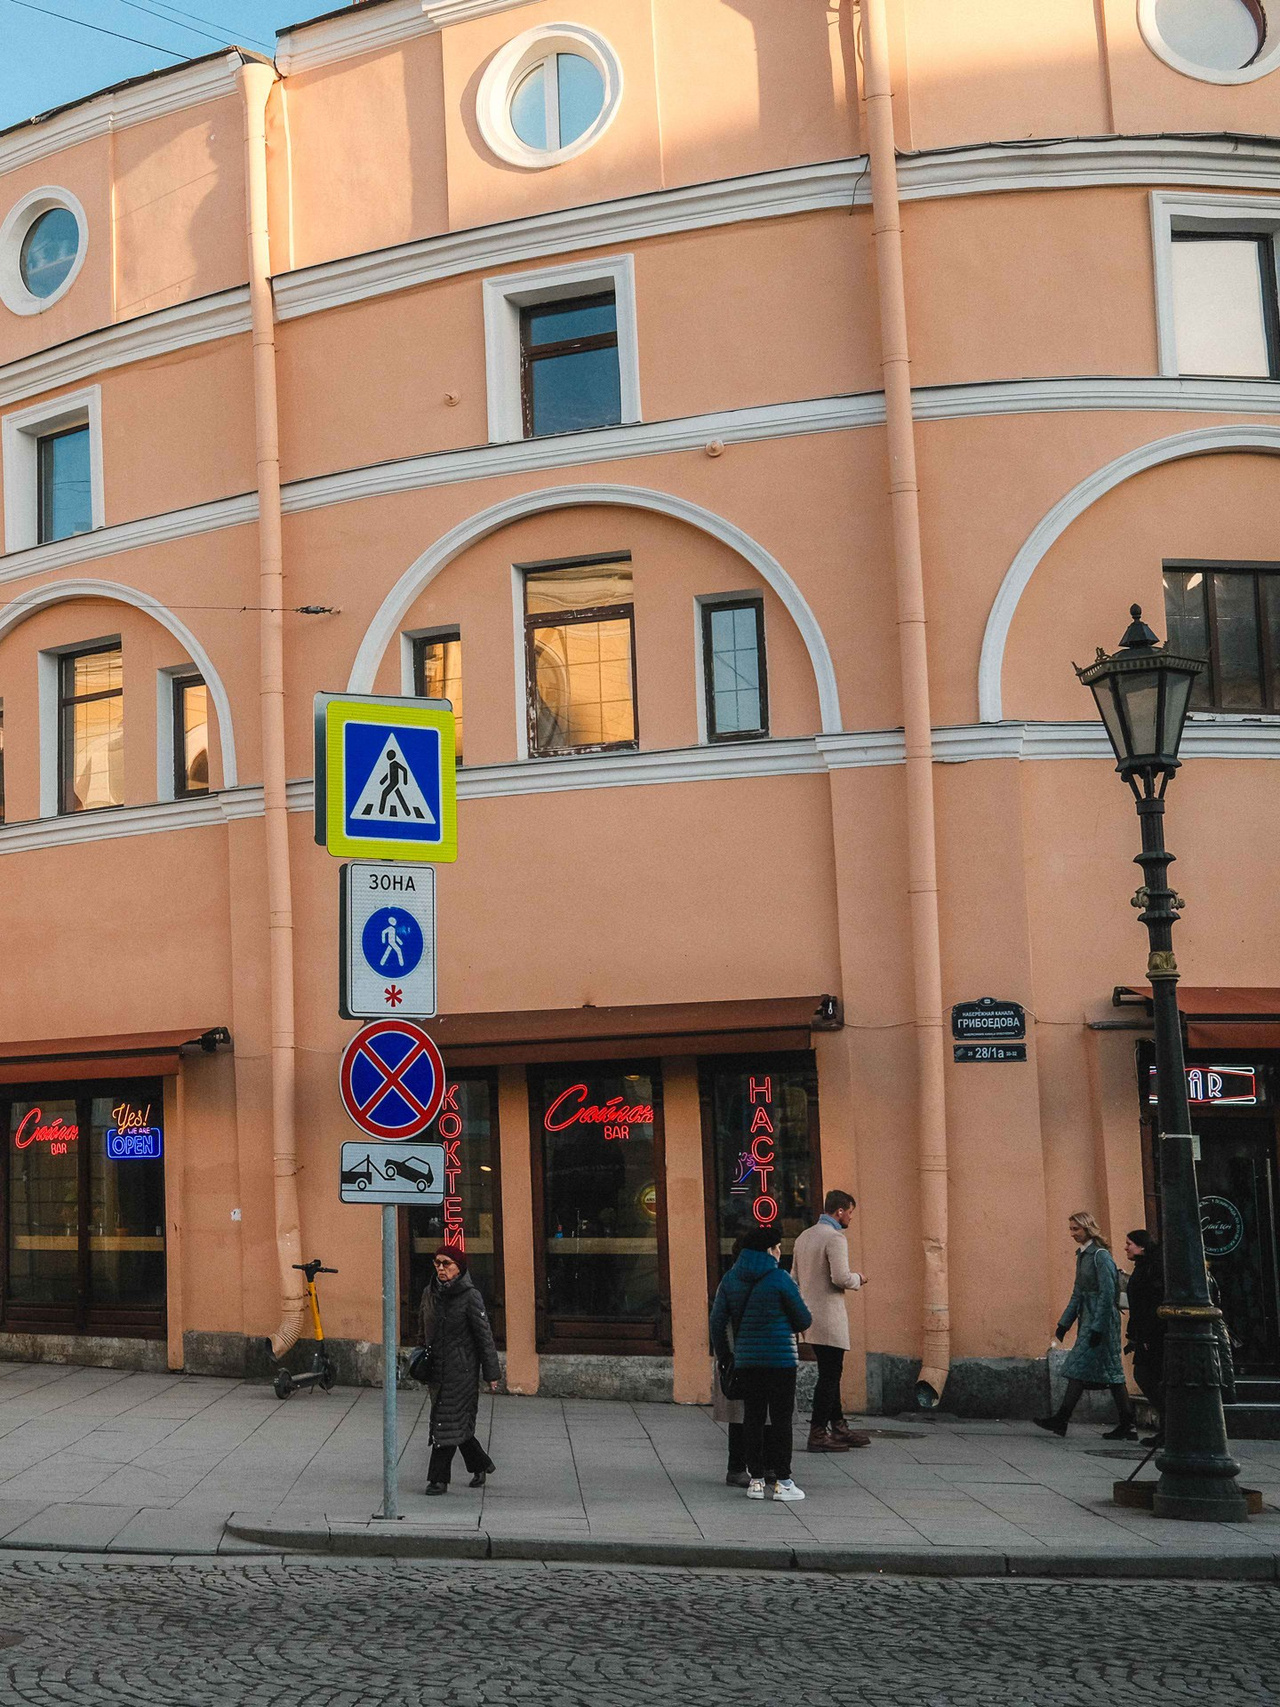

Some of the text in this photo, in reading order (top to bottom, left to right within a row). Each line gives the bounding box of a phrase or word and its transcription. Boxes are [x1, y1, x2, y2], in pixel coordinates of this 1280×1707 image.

[369, 873, 416, 892] ЗОНА
[957, 1016, 1021, 1029] ГРИБОЕДОВА
[1187, 1069, 1223, 1100] AR
[112, 1102, 151, 1135] Yes!
[127, 1126, 151, 1135] WE ARE
[603, 1125, 630, 1140] BAR
[50, 1142, 68, 1156] BAR
[111, 1134, 153, 1155] OPEN
[749, 1076, 779, 1229] НАСТО
